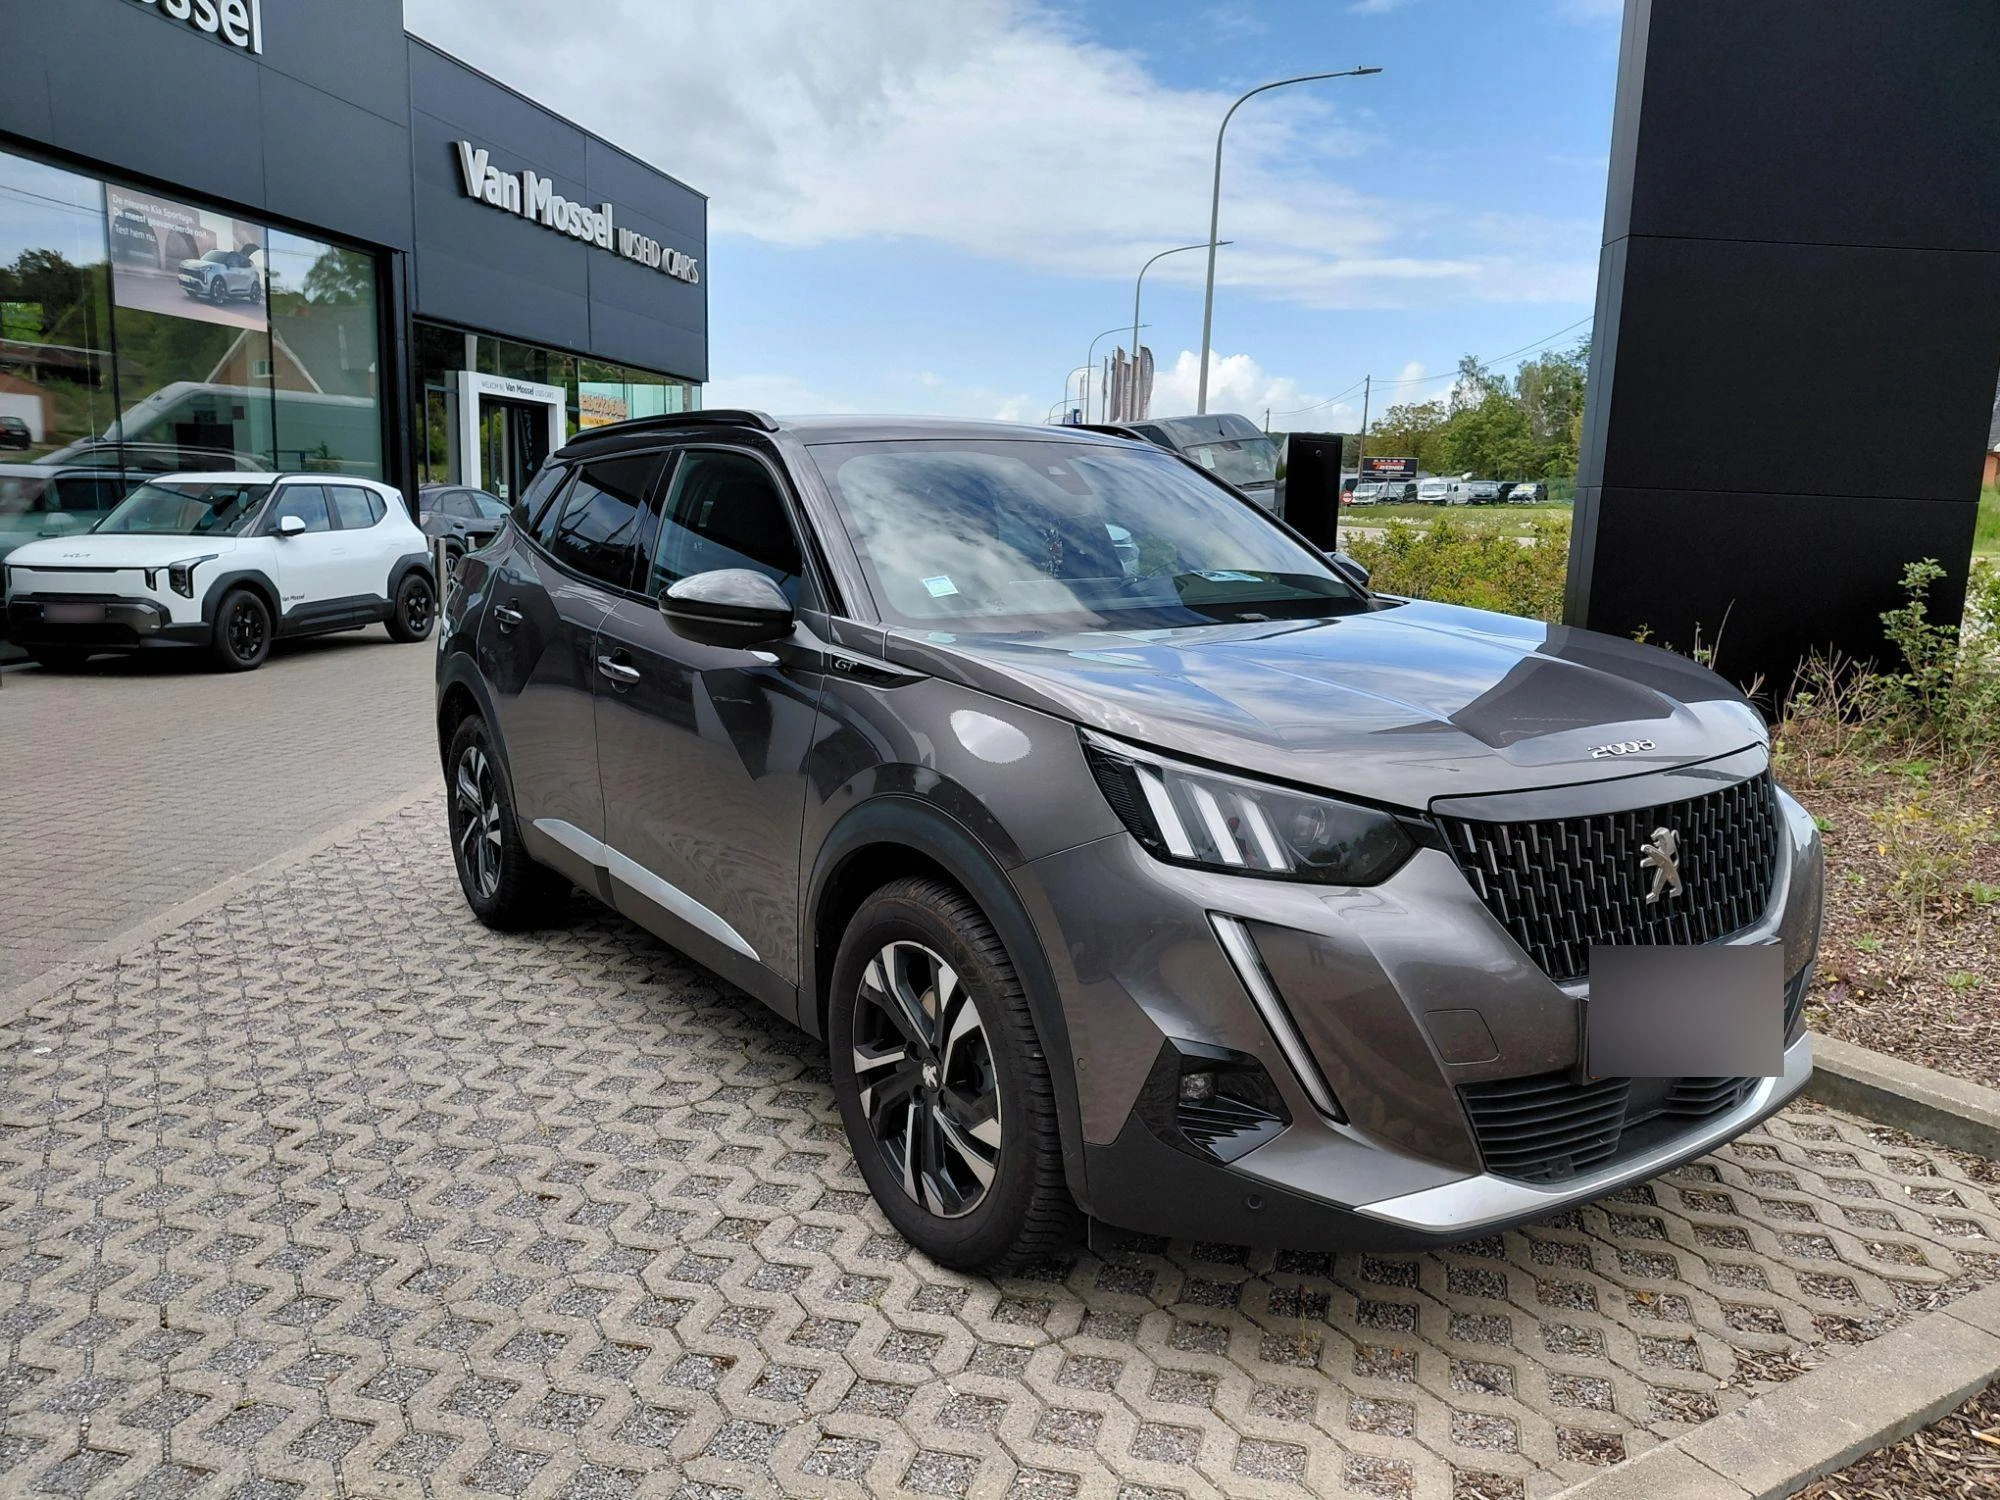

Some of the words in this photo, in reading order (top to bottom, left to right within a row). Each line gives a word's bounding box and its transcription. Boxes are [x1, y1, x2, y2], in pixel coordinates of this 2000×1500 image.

[112, 194, 122, 204] De
[150, 204, 162, 215] Kia
[458, 140, 520, 213] Van
[523, 170, 613, 250] Mossel
[619, 228, 660, 268] USED
[662, 248, 699, 284] CARS
[112, 207, 123, 218] De
[124, 211, 146, 223] meest
[115, 224, 129, 235] Test
[130, 228, 145, 239] hem
[505, 382, 516, 392] Van
[516, 384, 535, 396] Mossel
[834, 659, 858, 673] GT
[1587, 739, 1656, 760] 2008
